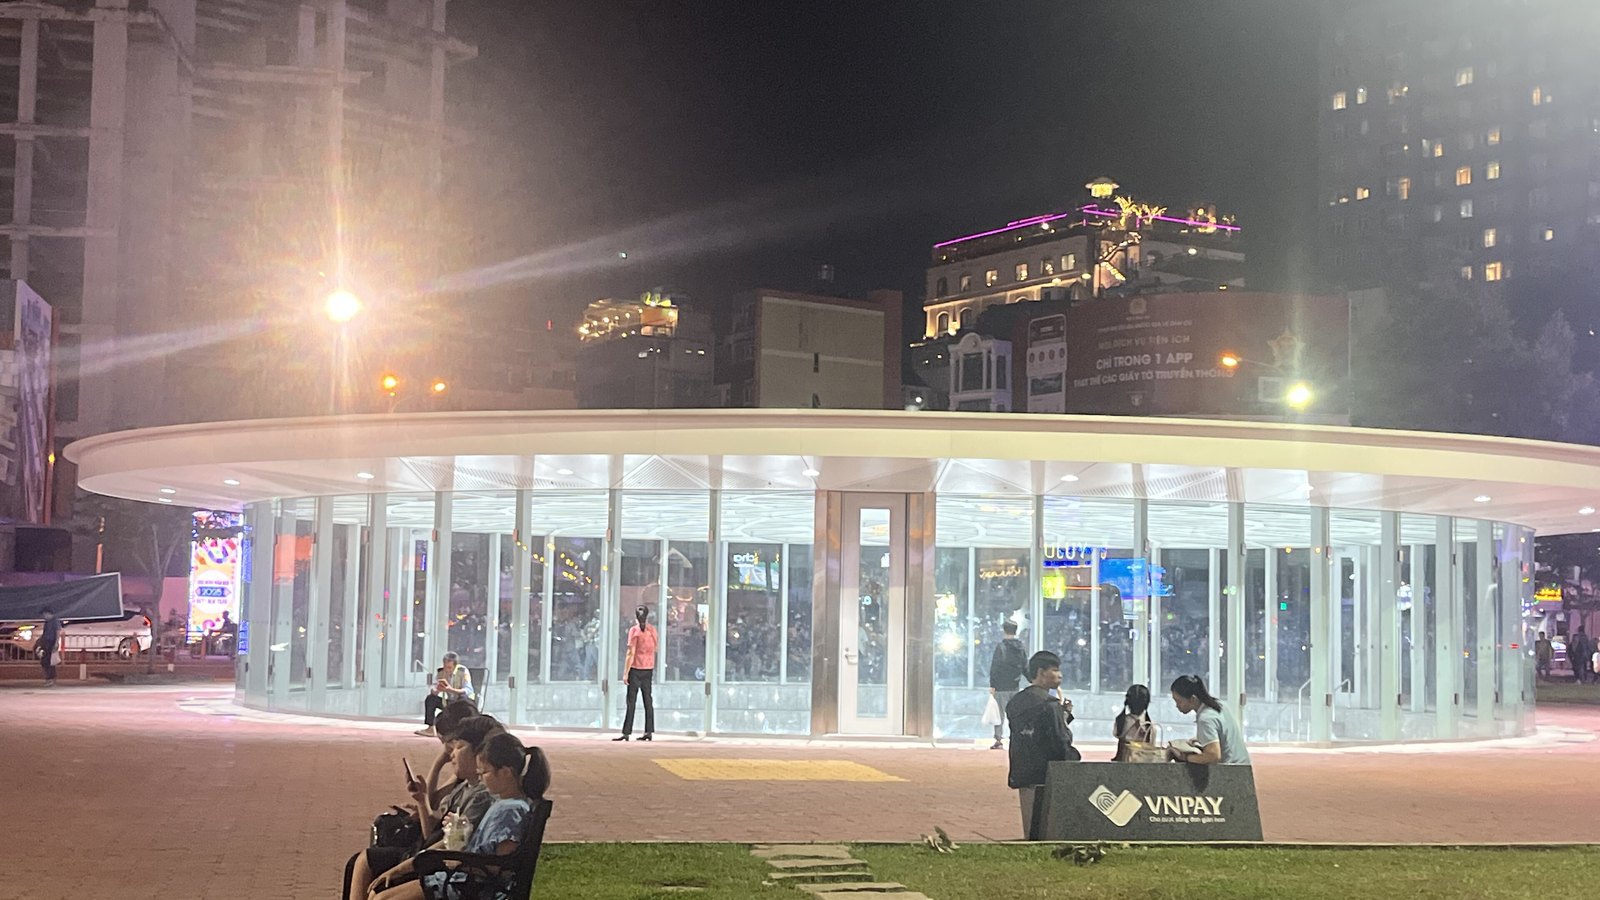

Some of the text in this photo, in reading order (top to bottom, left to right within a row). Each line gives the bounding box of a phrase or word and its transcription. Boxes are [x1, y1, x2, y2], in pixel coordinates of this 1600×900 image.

[1113, 353, 1151, 368] TRONG
[1155, 353, 1161, 364] 1
[1166, 352, 1193, 364] APP
[1102, 373, 1117, 384] CÁC
[1144, 795, 1224, 815] VNPAY
